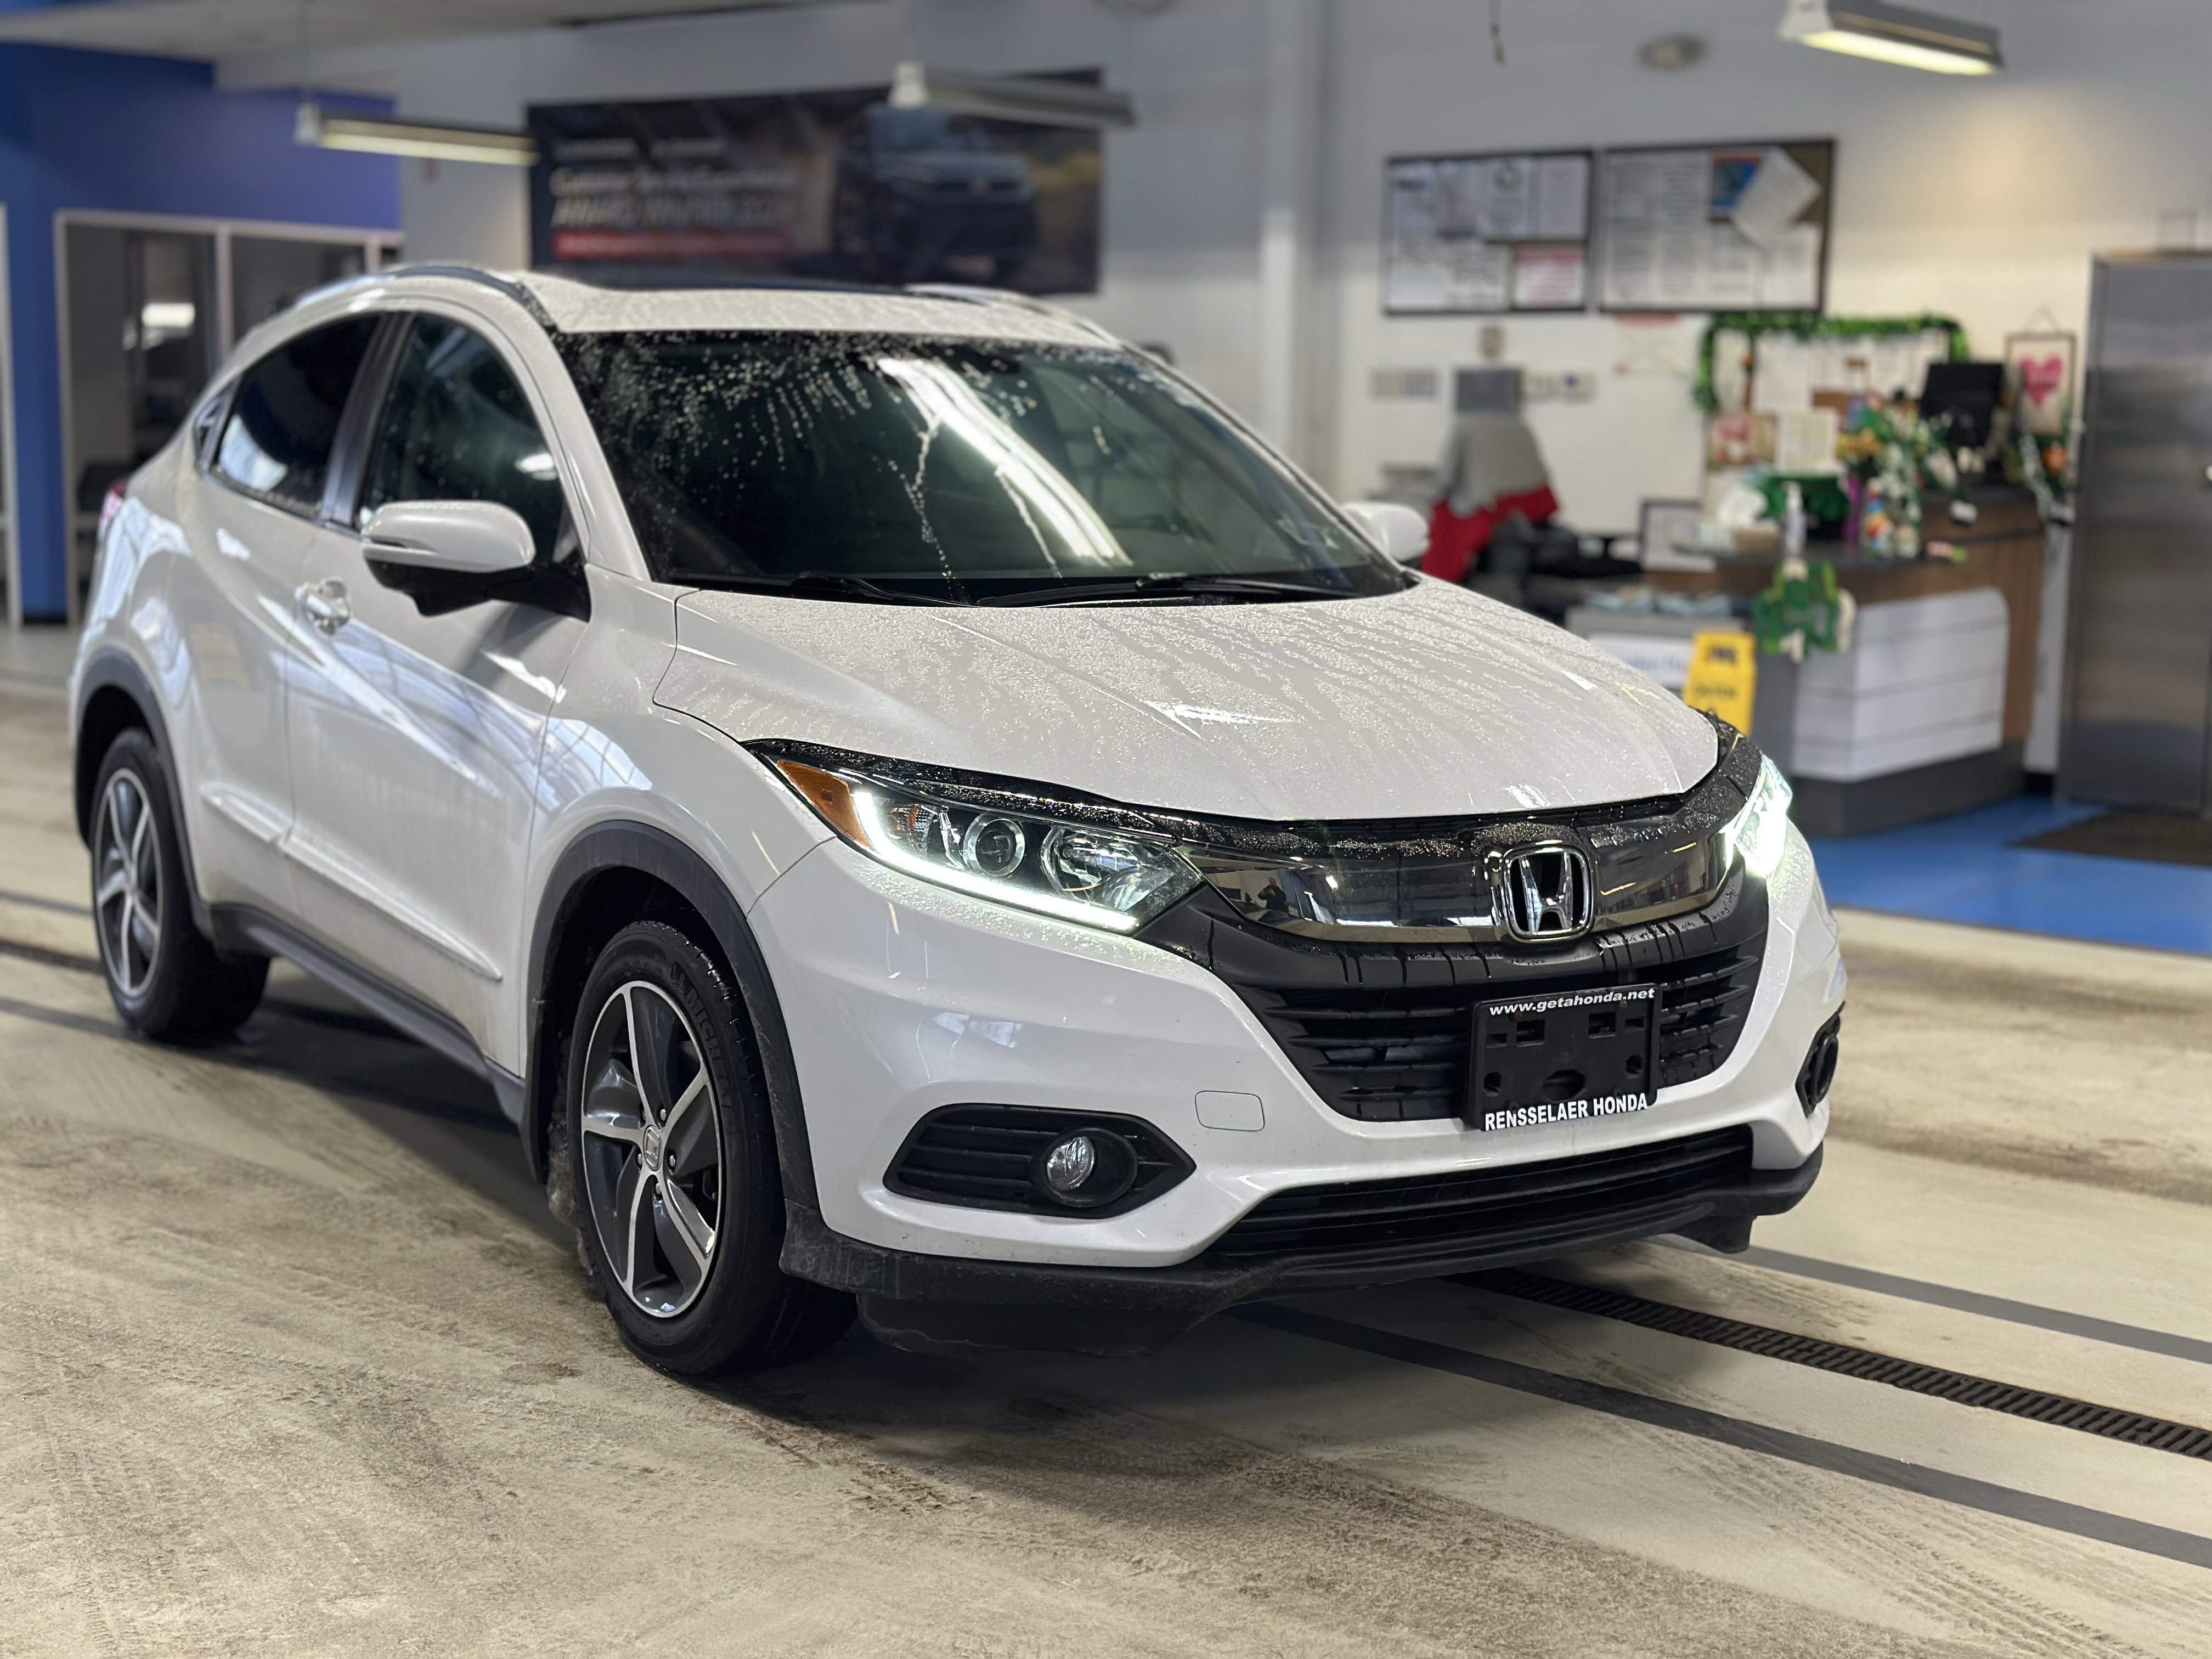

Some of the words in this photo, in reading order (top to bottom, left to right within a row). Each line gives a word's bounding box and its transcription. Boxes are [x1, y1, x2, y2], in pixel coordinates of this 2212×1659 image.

[1489, 988, 1655, 1015] www.getahonda.net
[1485, 1100, 1589, 1131] RENSSELAER
[1593, 1093, 1647, 1116] HONDA
